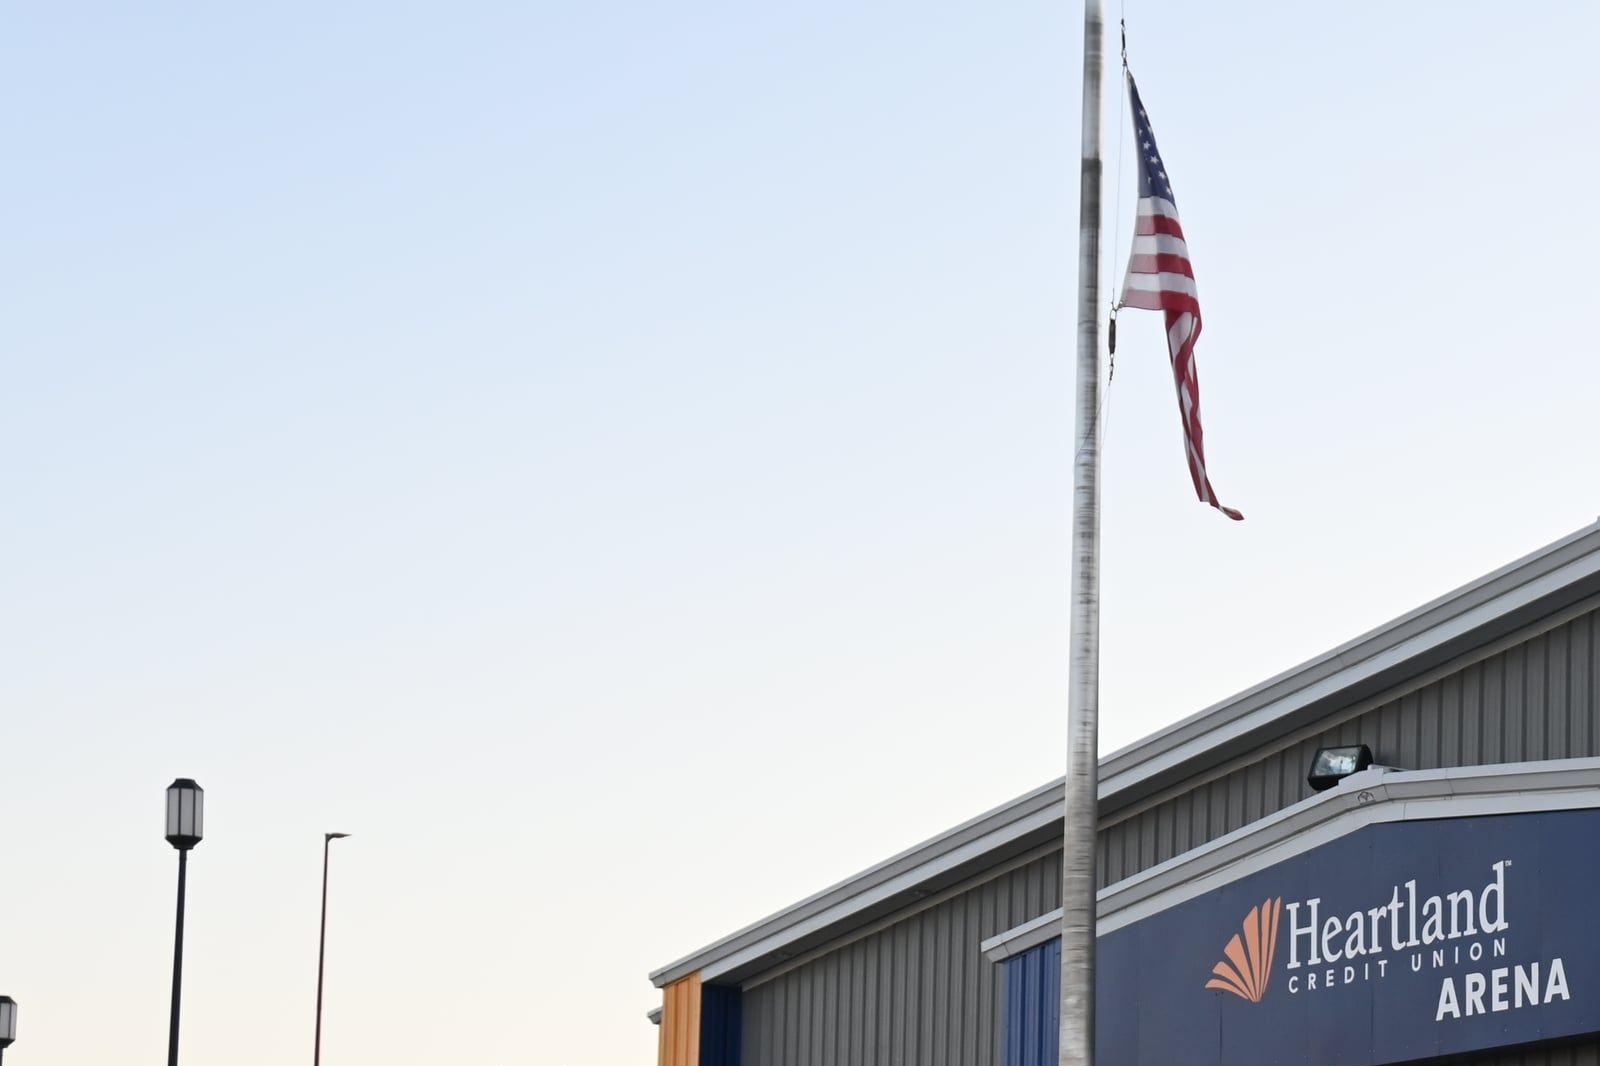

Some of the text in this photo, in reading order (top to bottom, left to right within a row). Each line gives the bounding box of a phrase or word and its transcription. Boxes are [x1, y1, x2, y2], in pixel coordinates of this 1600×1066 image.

[1286, 861, 1509, 969] Heartland
[1289, 938, 1505, 993] CREDIT UNION
[1436, 958, 1570, 1021] ARENA
